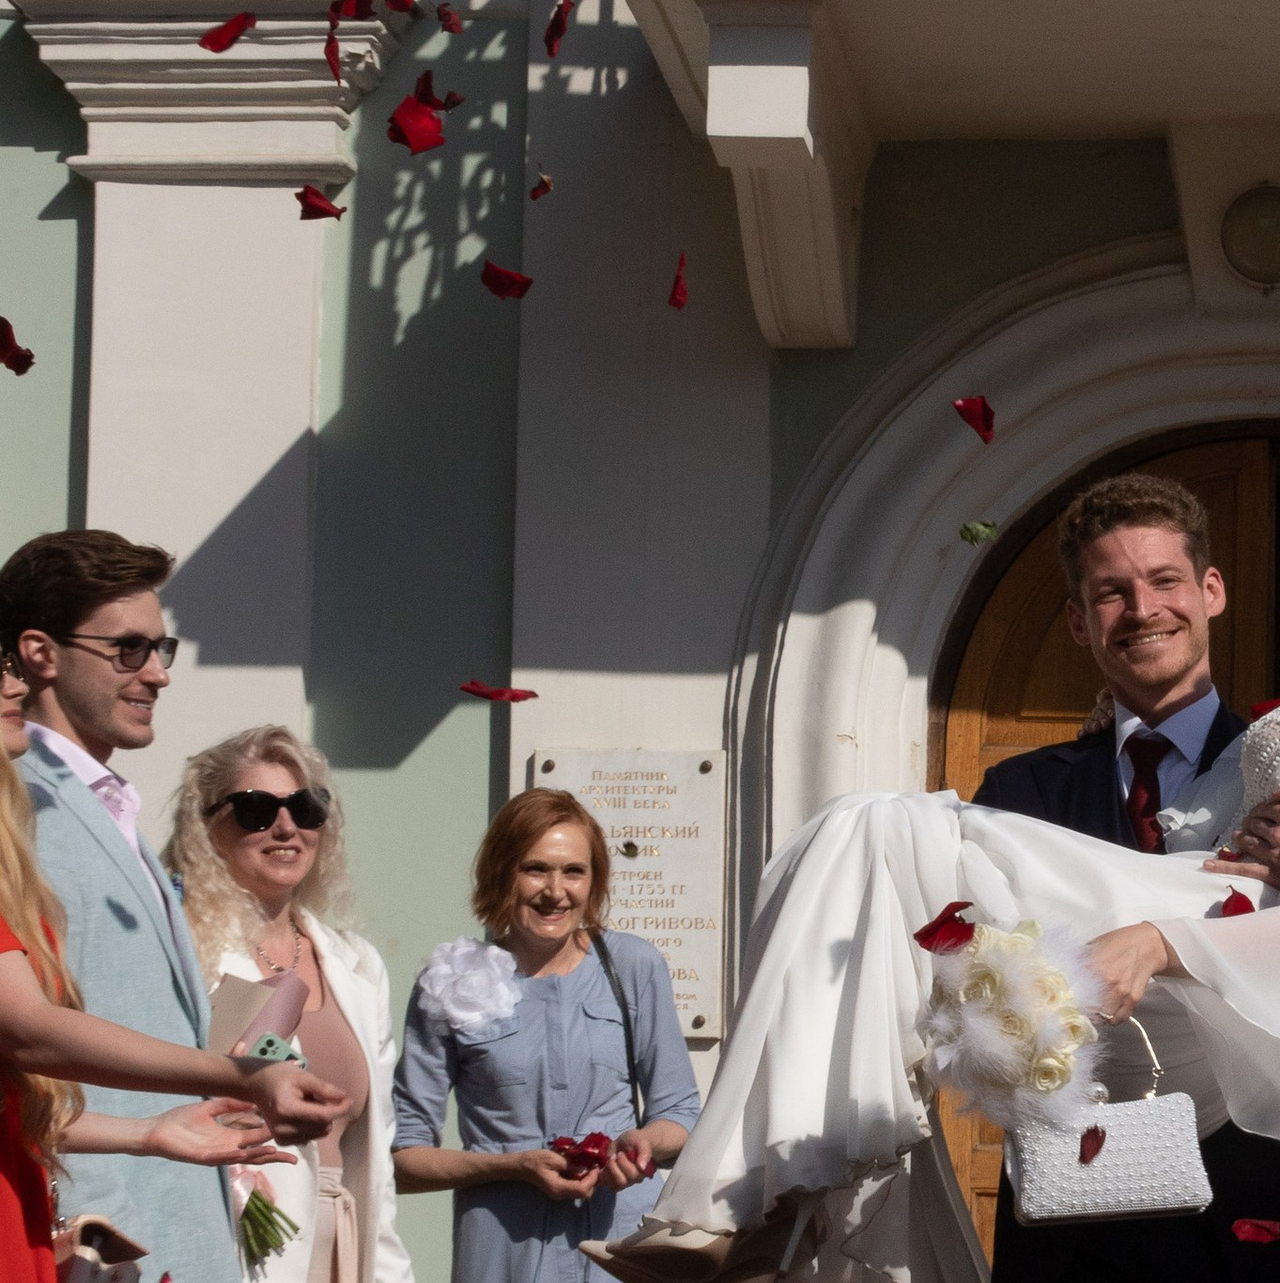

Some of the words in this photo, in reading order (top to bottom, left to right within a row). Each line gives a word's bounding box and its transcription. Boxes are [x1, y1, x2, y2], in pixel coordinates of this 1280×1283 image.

[580, 785, 677, 795] АРХИТЕКТУРЫ
[633, 799, 671, 809] ВЕКА
[602, 821, 699, 838] ЬЯНСКИЙ
[611, 871, 662, 881] СТРОЕН
[607, 917, 717, 930] ЛОГРИВОВА
